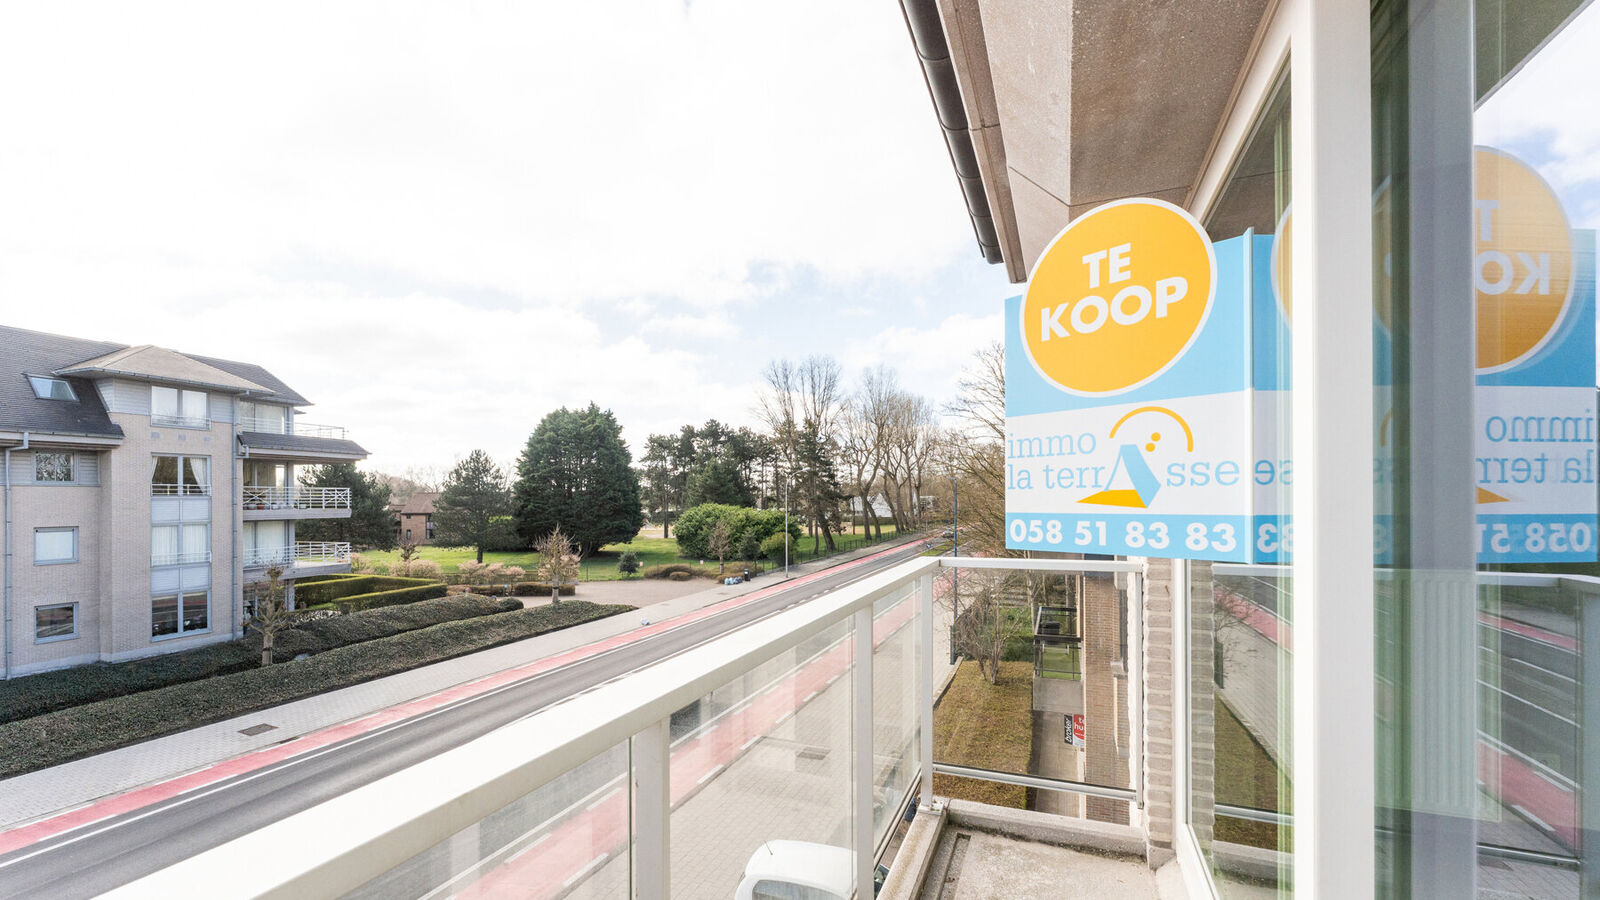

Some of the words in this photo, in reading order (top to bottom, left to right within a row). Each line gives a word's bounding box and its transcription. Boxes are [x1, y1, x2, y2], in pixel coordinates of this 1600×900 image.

[1082, 242, 1131, 289] TE
[1041, 276, 1188, 342] KOOP
[1008, 432, 1097, 459] immo
[1008, 464, 1033, 490] la
[1010, 519, 1063, 544] 058
[1075, 521, 1107, 546] 51
[1125, 521, 1169, 549] 83
[1185, 523, 1237, 553] 83
